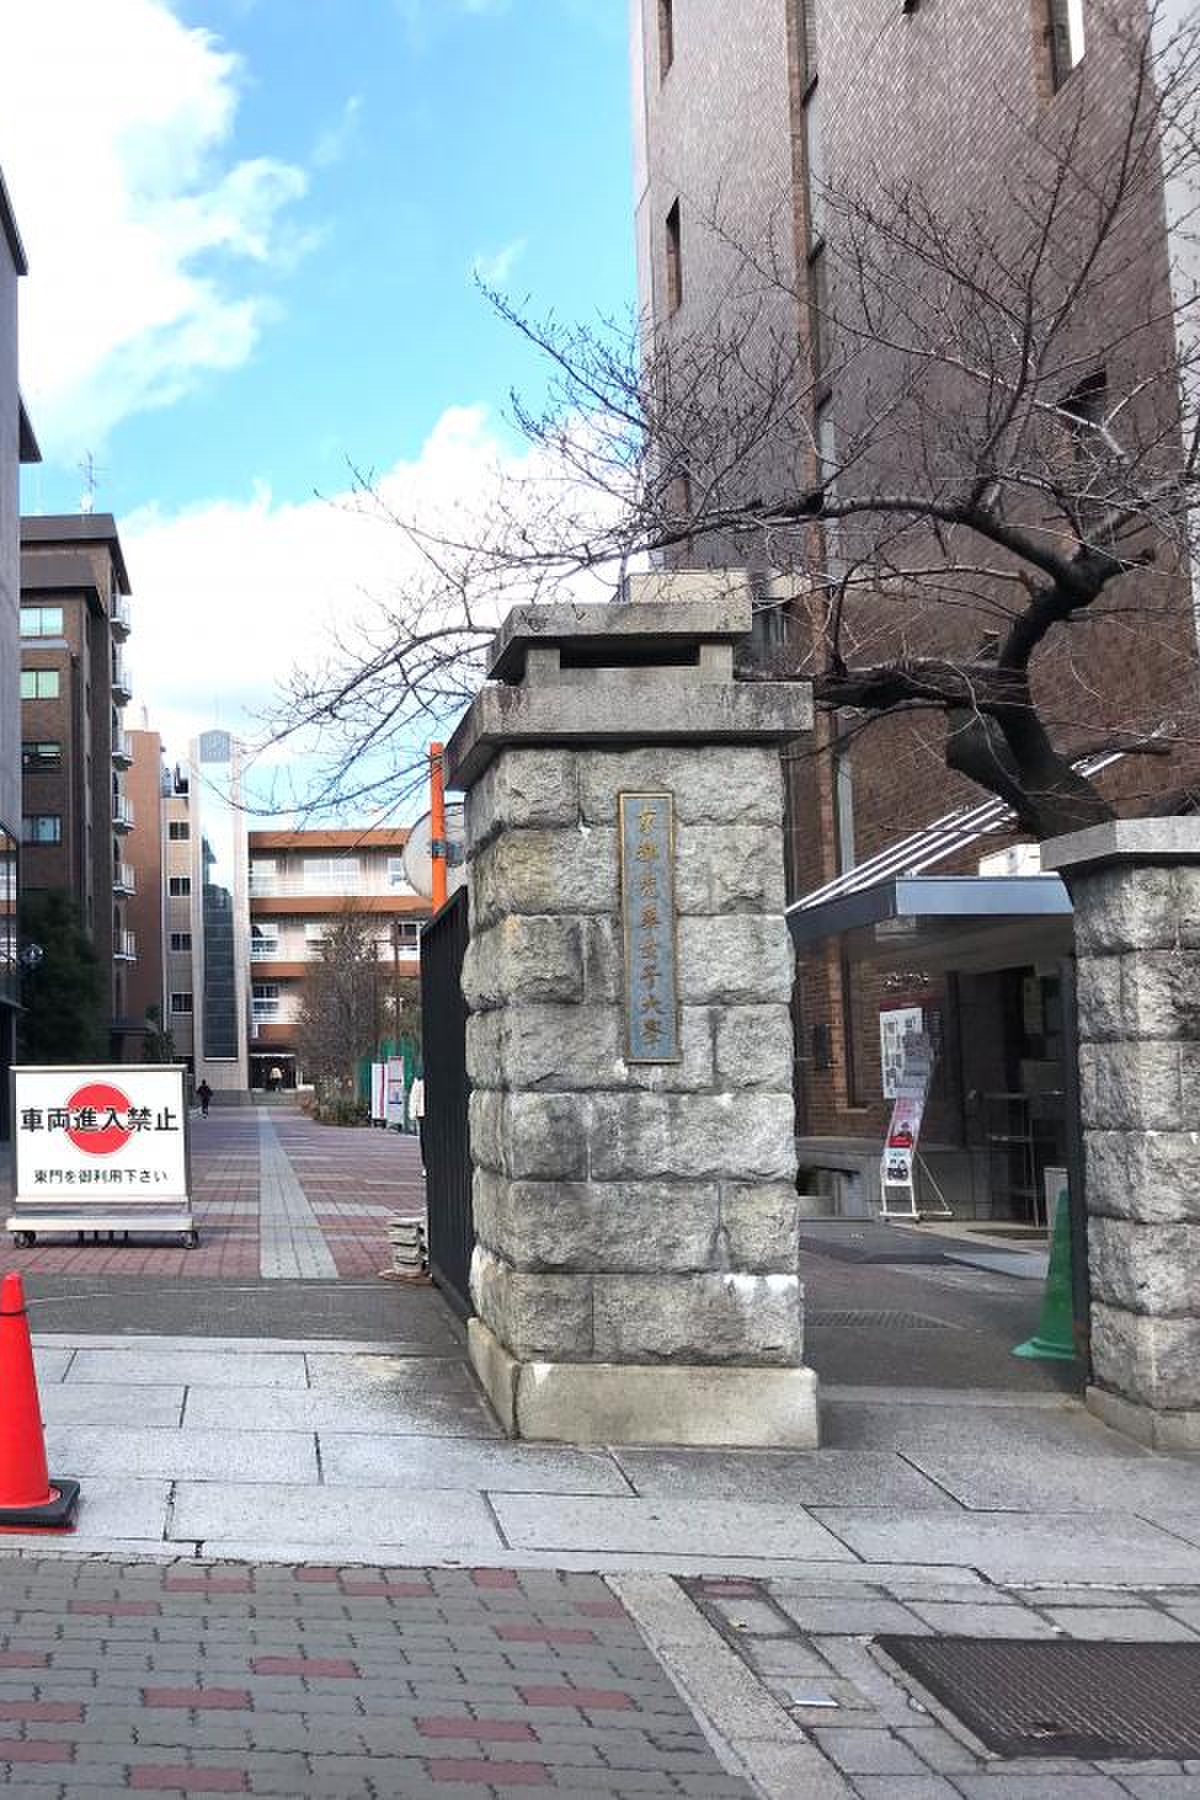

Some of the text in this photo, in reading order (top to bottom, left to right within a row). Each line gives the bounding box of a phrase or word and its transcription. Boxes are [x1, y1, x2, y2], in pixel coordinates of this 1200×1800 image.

[20, 1107, 179, 1132] 車両進入禁止
[34, 1169, 168, 1184] 東門を御利用下さい
